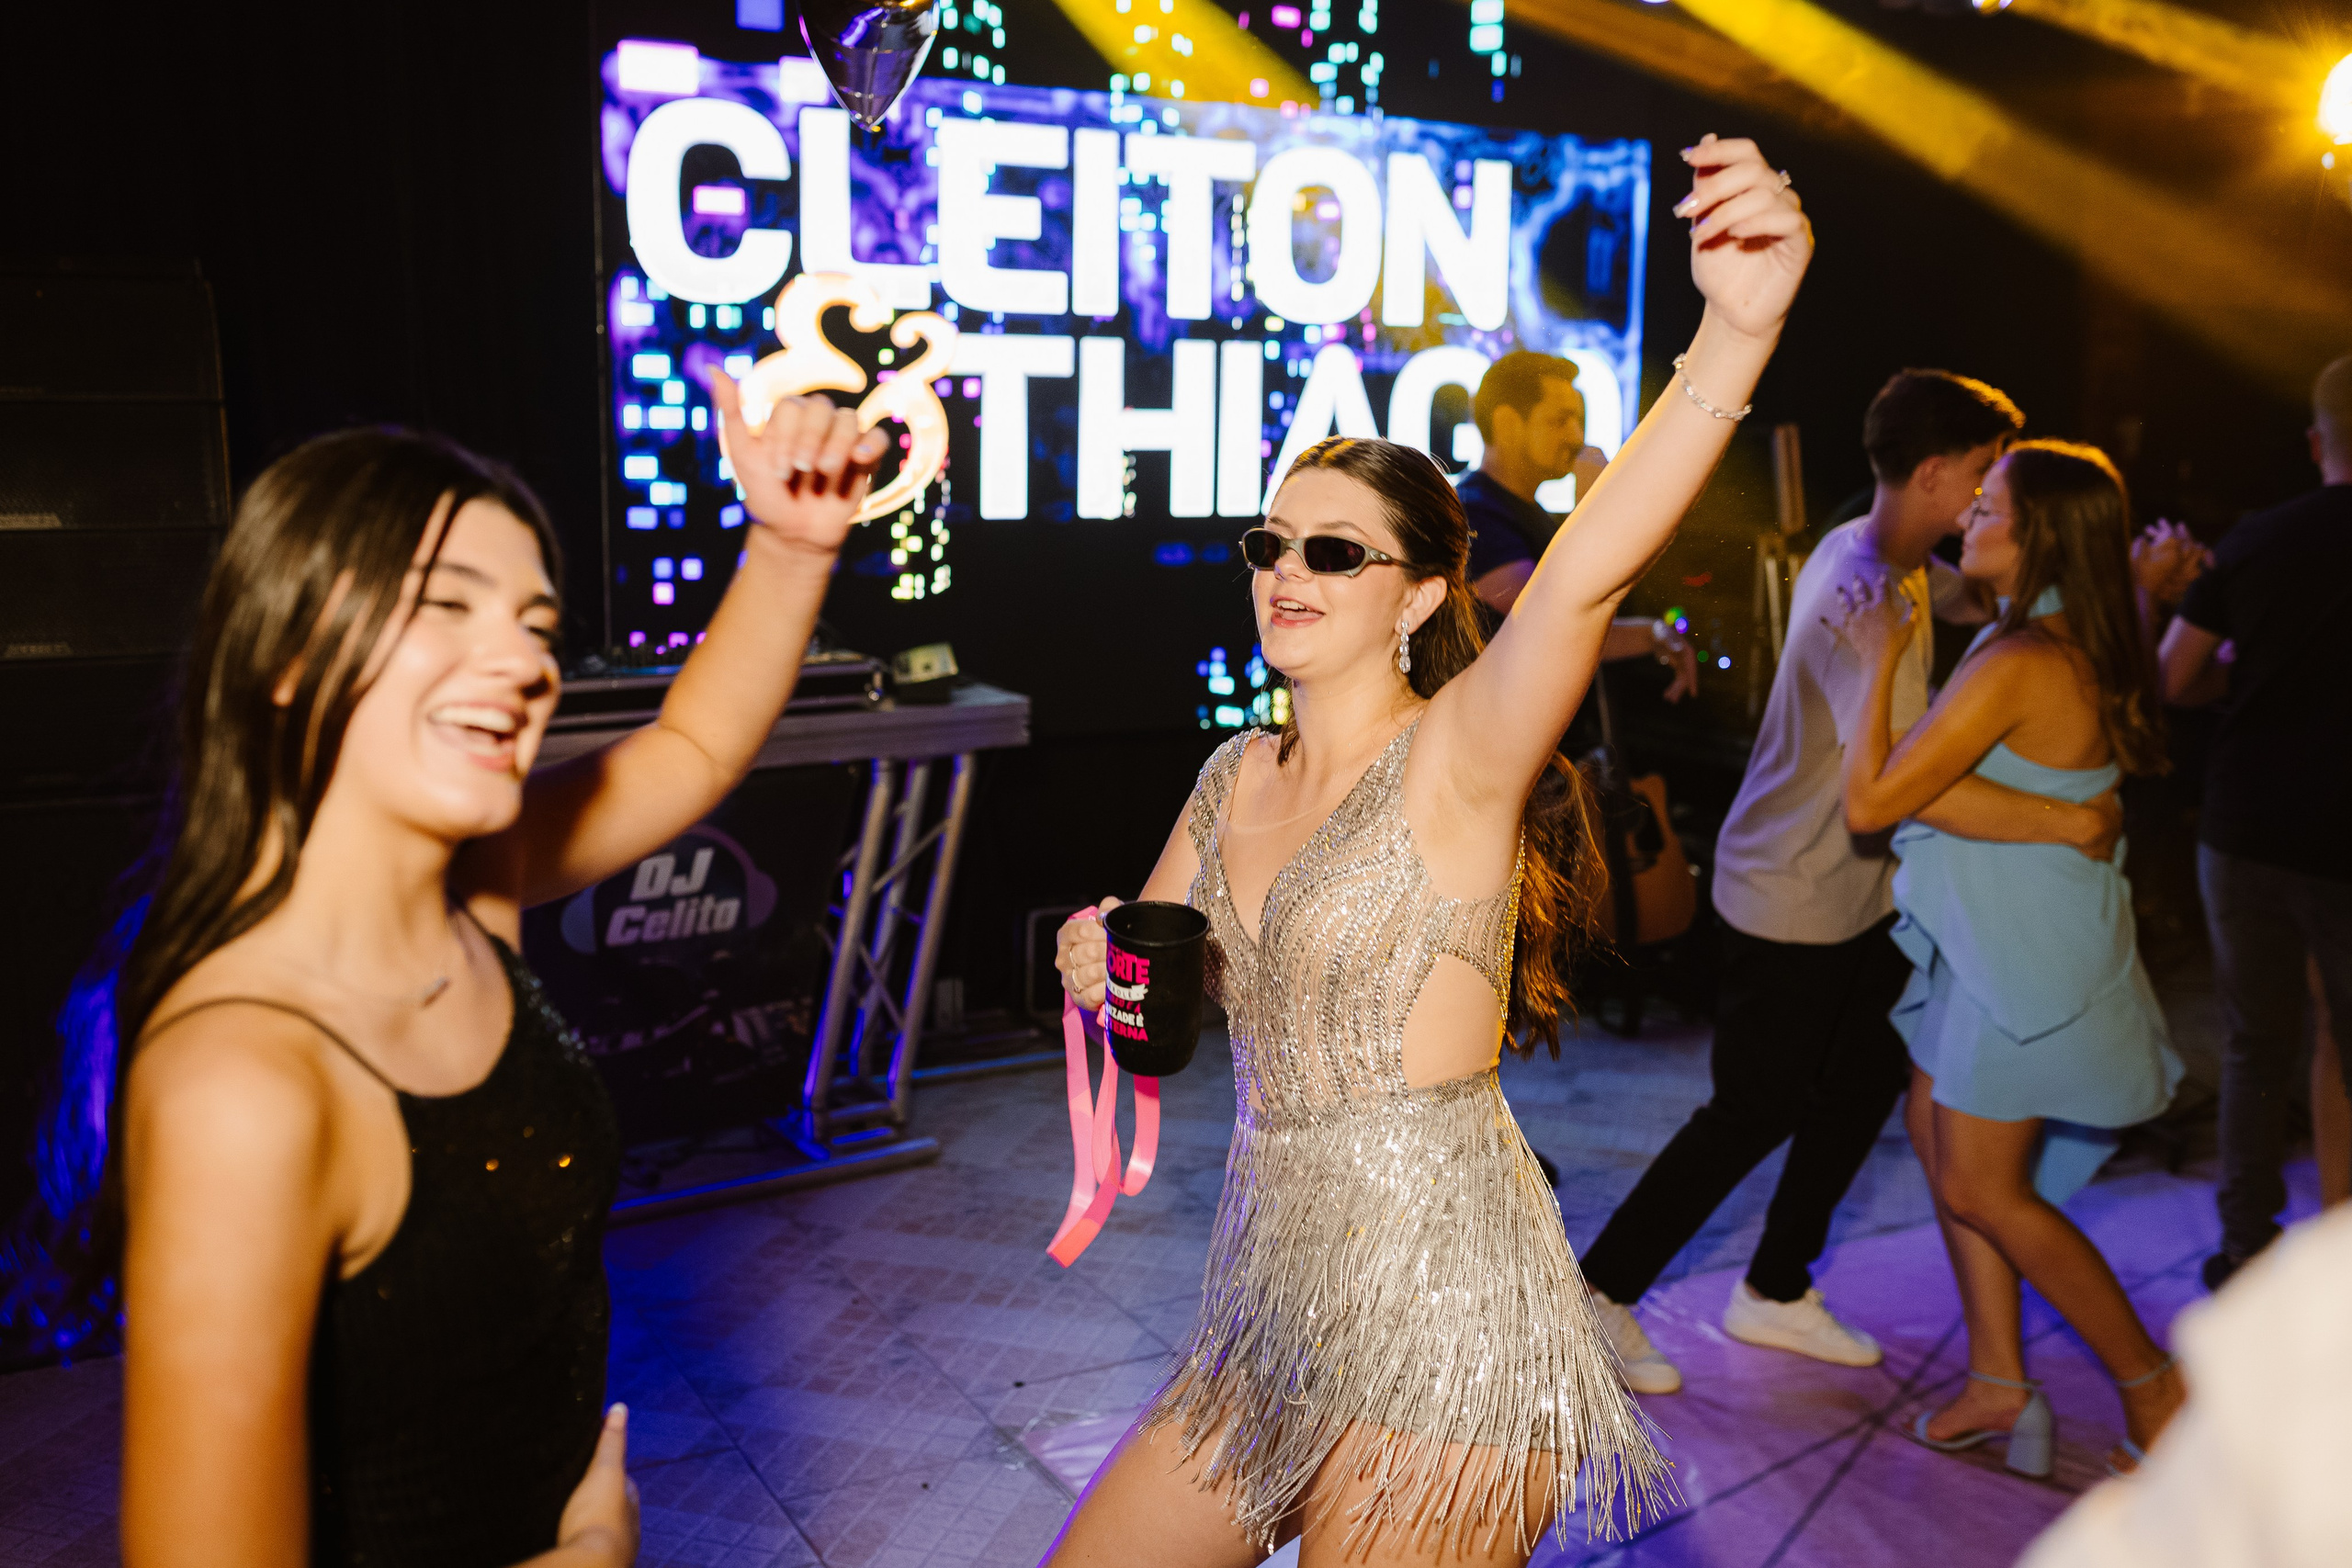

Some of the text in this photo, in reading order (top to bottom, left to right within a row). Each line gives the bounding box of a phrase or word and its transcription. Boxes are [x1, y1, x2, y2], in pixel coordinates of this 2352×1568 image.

[625, 96, 1513, 332] CLEITON
[630, 846, 715, 902] DJ
[605, 894, 741, 947] Celito
